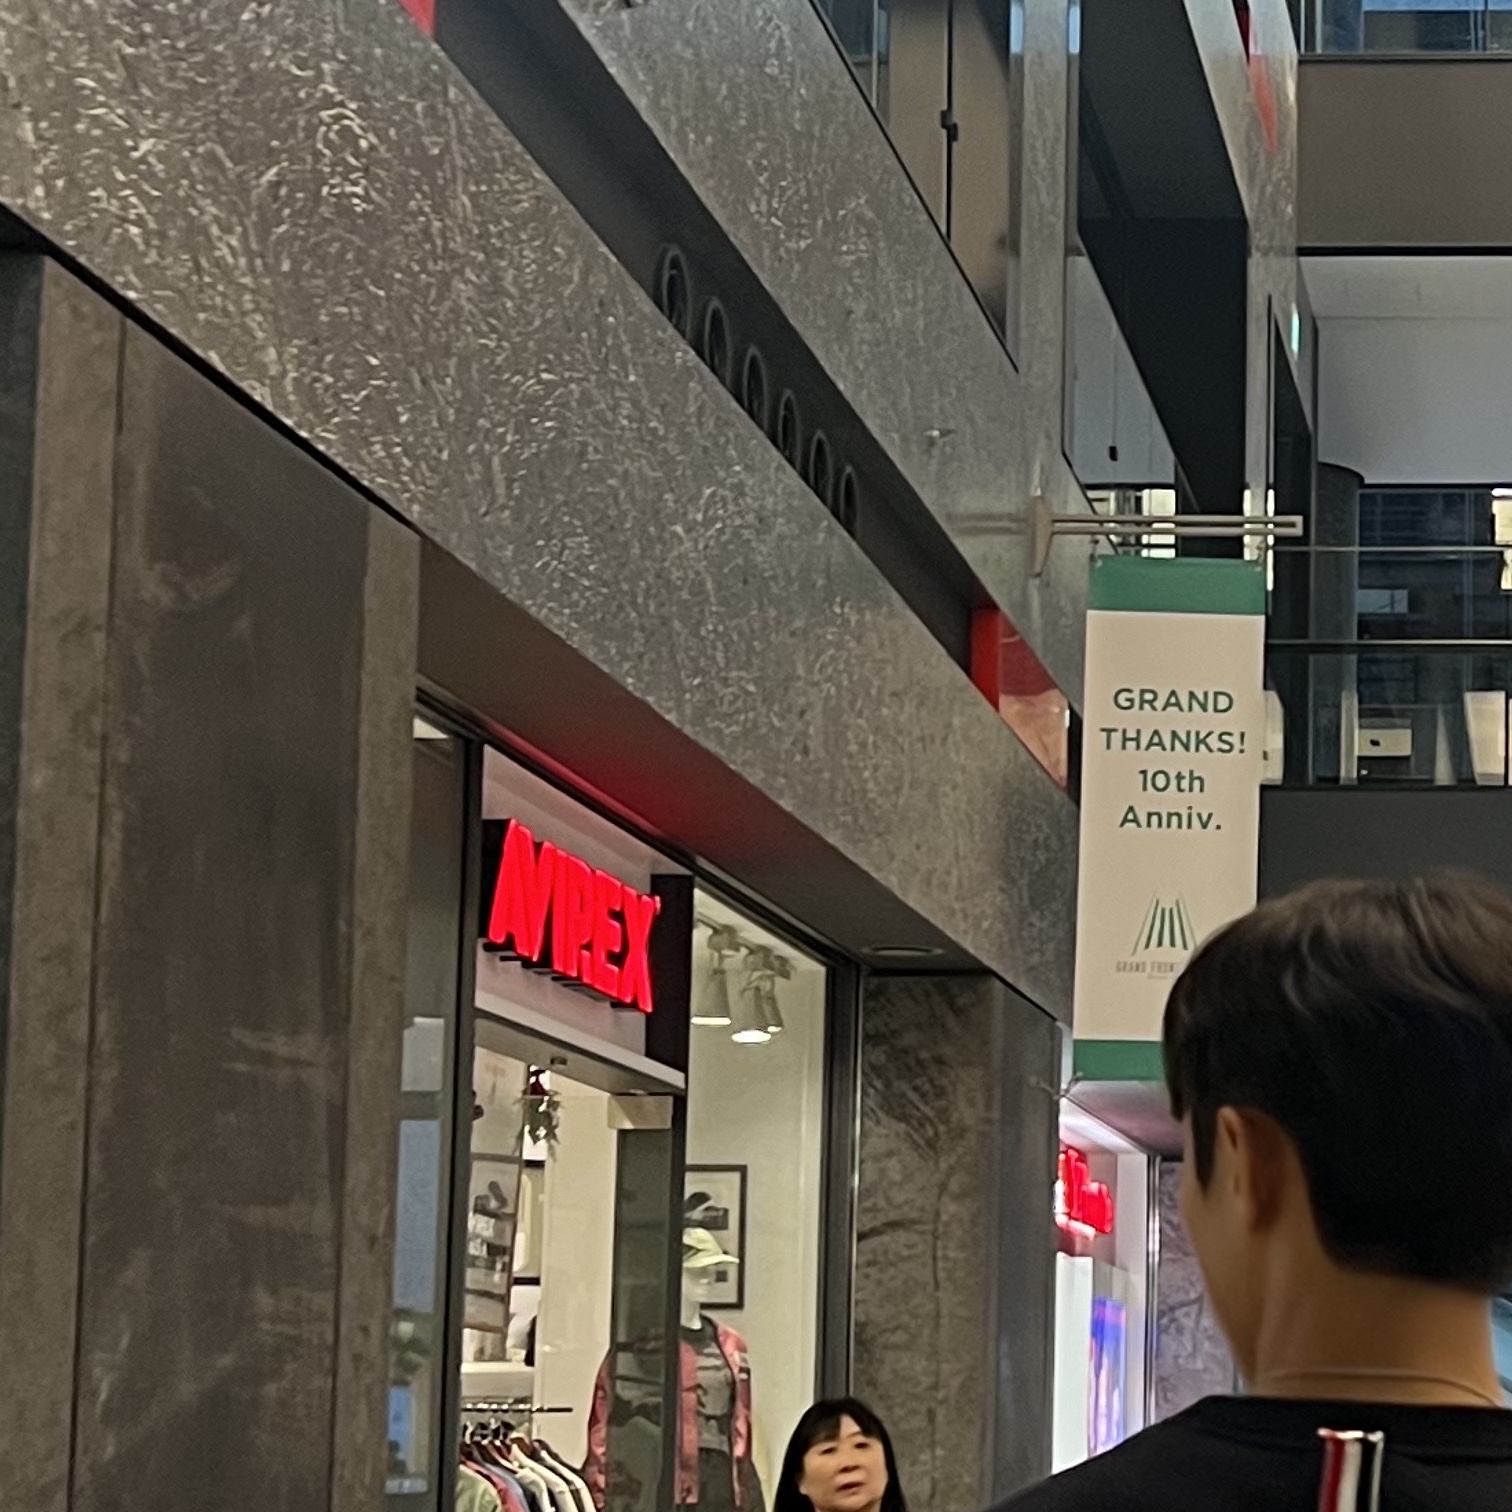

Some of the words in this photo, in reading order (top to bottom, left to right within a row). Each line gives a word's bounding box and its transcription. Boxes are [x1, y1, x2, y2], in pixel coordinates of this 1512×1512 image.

[1113, 688, 1234, 714] GRAND
[1100, 727, 1247, 754] THANKS!
[1137, 769, 1206, 794] 10th
[1119, 805, 1223, 831] Anniv.
